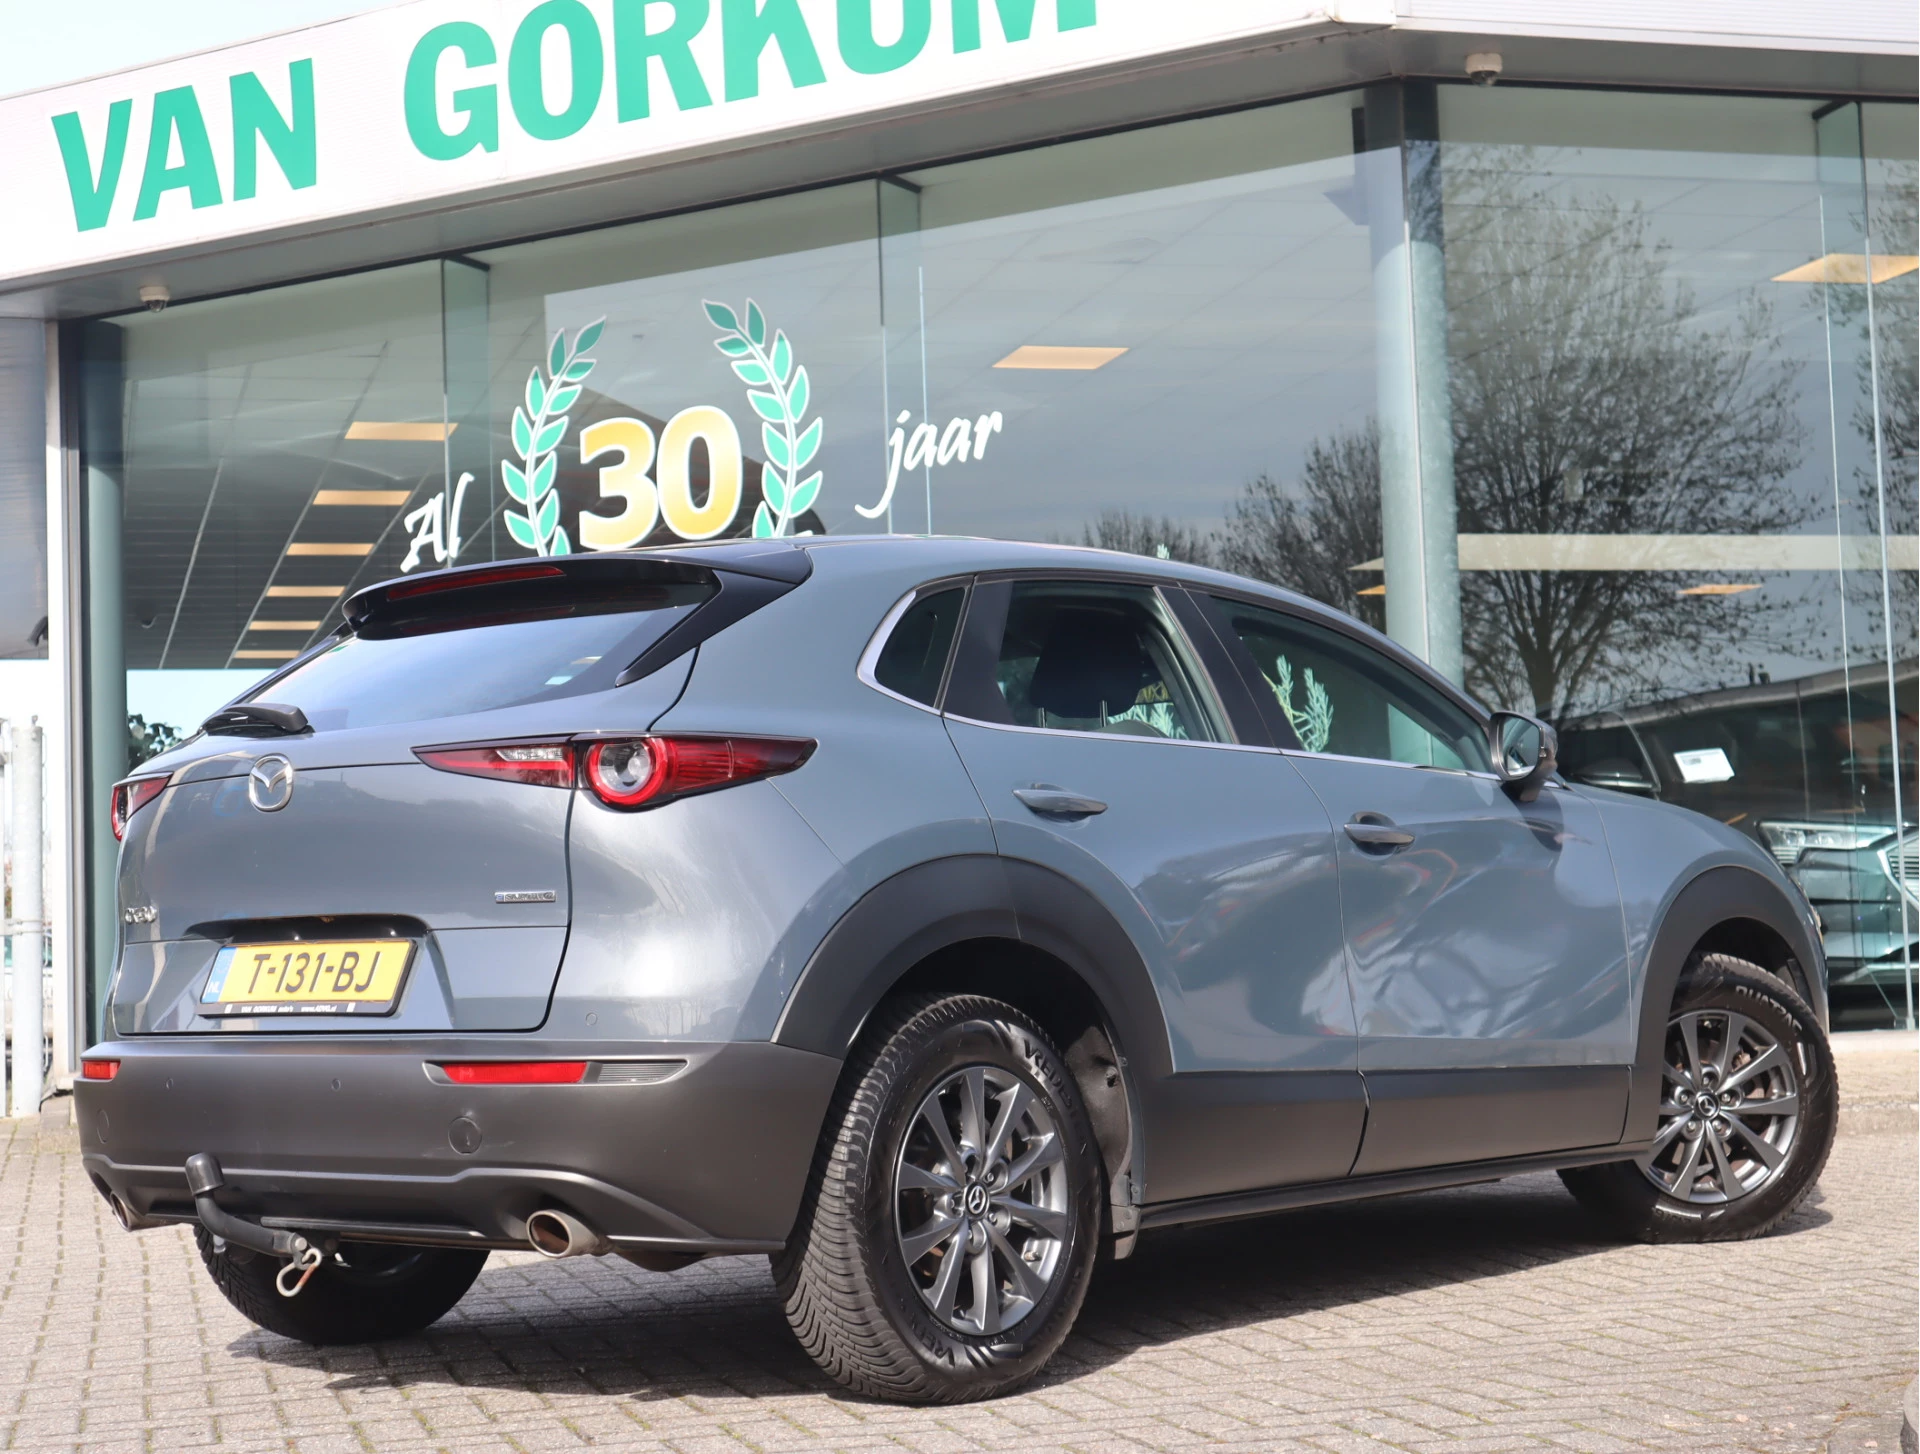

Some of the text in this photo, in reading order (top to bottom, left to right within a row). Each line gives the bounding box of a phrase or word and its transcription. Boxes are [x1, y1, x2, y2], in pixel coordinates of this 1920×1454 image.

[51, 57, 318, 233] VAN
[400, 405, 1003, 573] Al 30 jaar
[207, 982, 220, 994] NL
[248, 951, 381, 995] T-131-BJ
